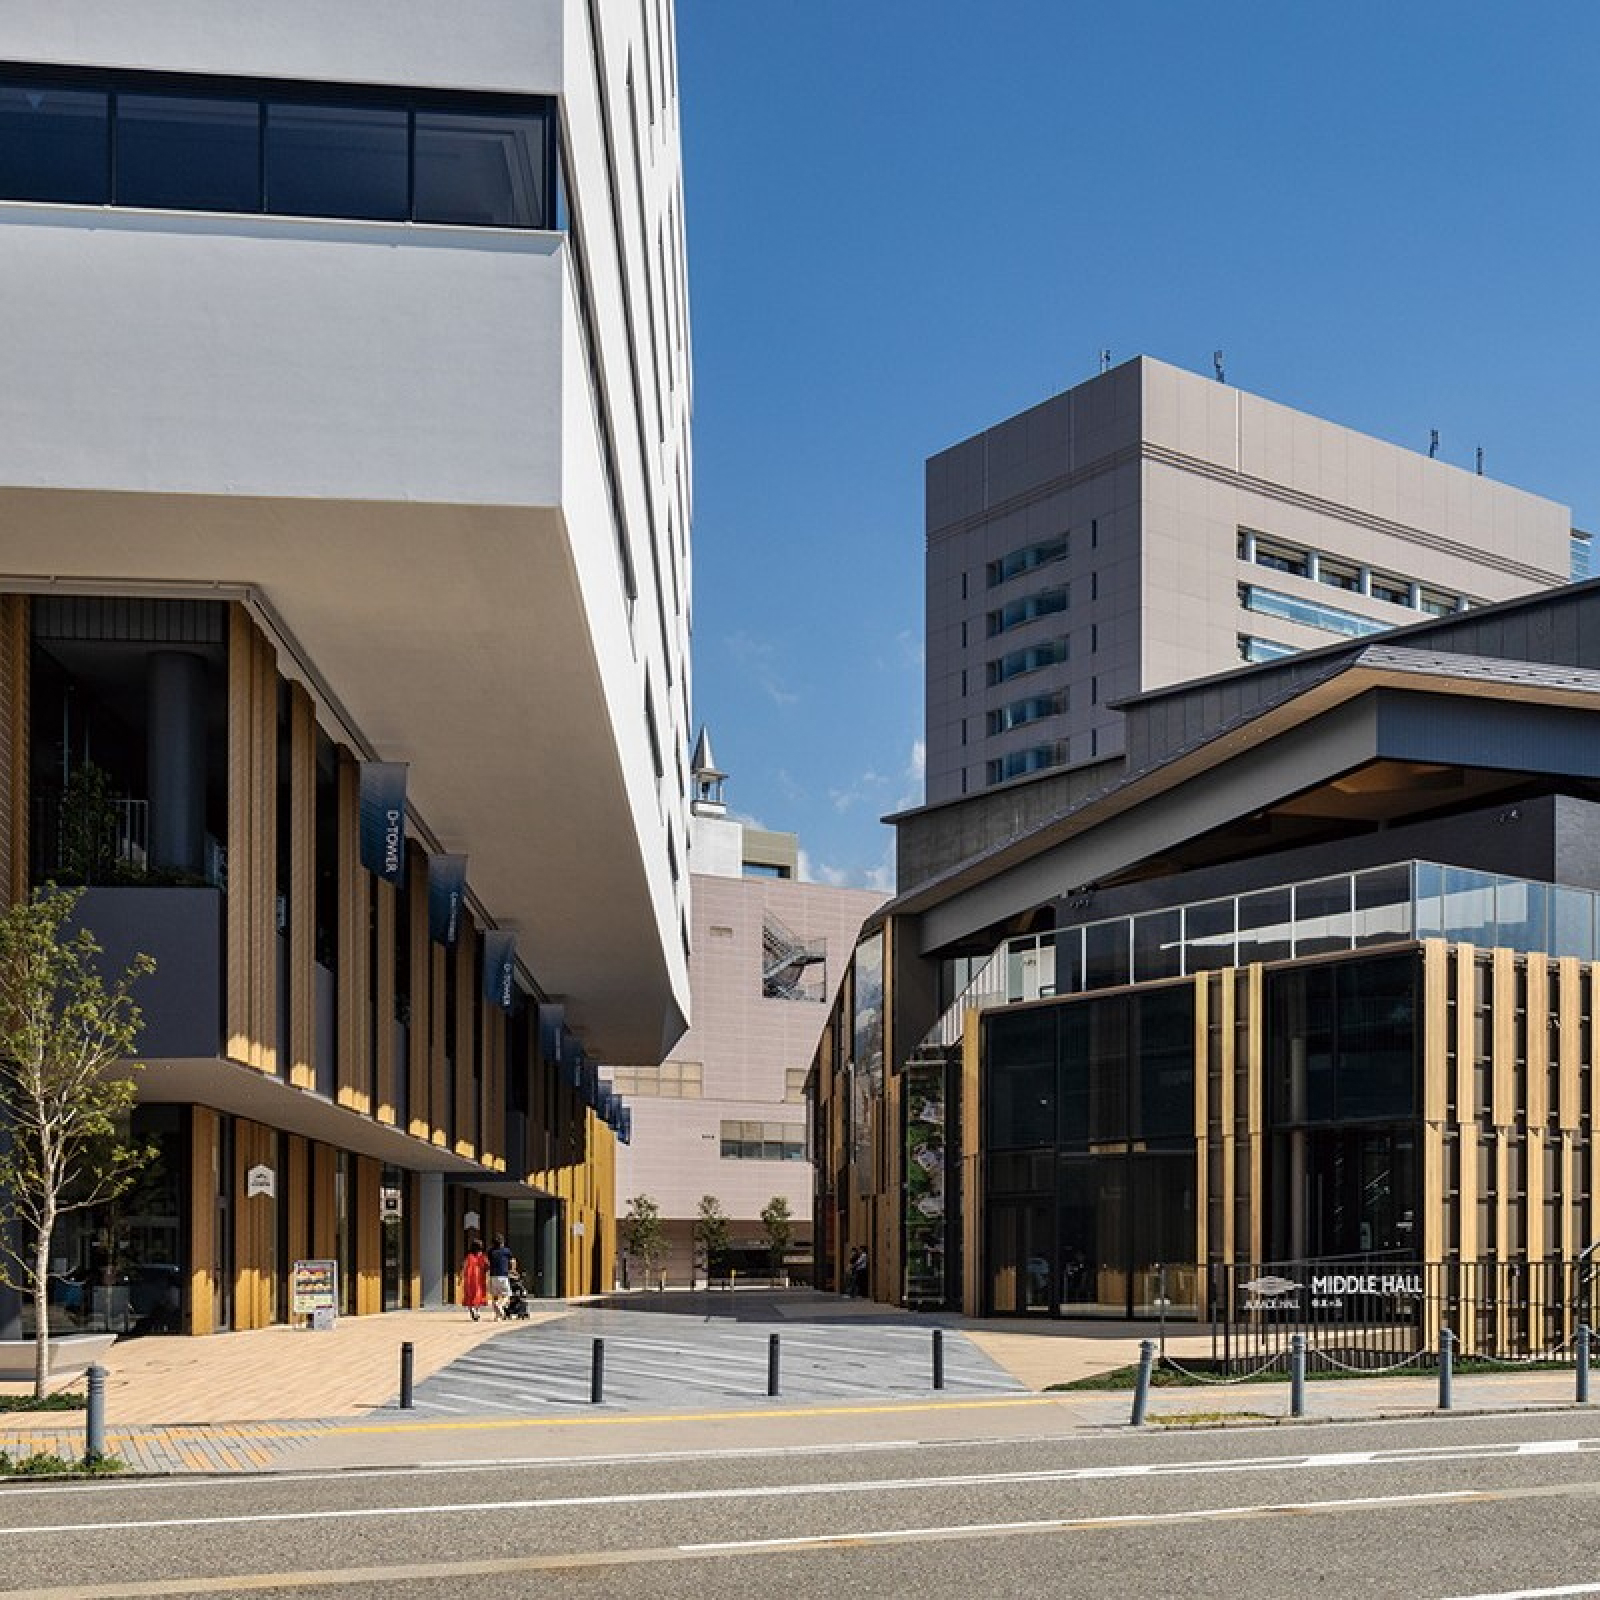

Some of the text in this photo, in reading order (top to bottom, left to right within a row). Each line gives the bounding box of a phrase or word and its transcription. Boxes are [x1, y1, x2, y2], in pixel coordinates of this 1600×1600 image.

[386, 810, 399, 873] D-TOWER
[1312, 1275, 1422, 1294] MIDDLE HALL
